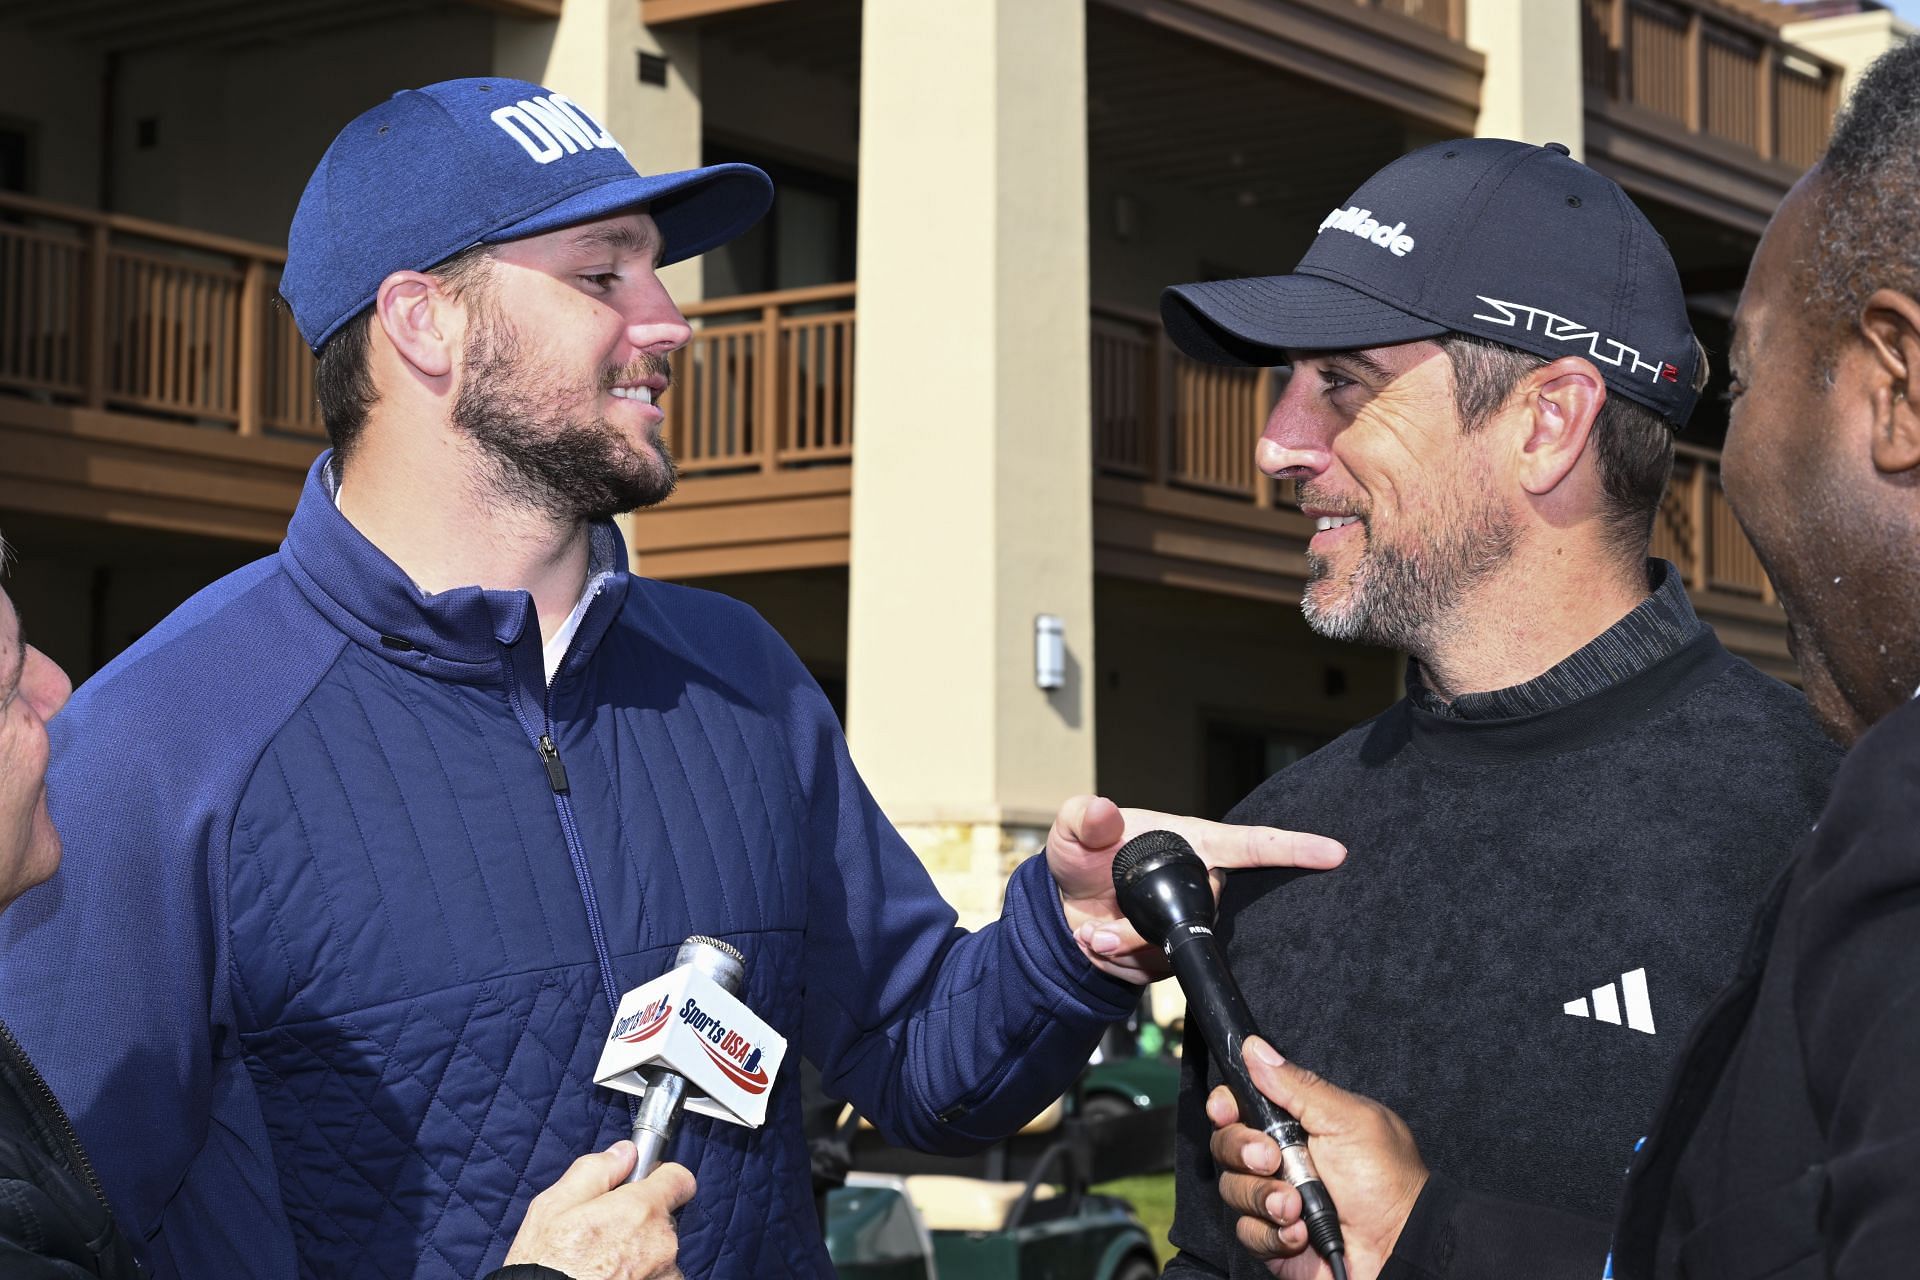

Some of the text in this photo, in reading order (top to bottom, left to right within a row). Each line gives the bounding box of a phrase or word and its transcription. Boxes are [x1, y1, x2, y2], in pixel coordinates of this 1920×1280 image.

[490, 93, 627, 164] ONC
[679, 998, 751, 1065] Sports USA
